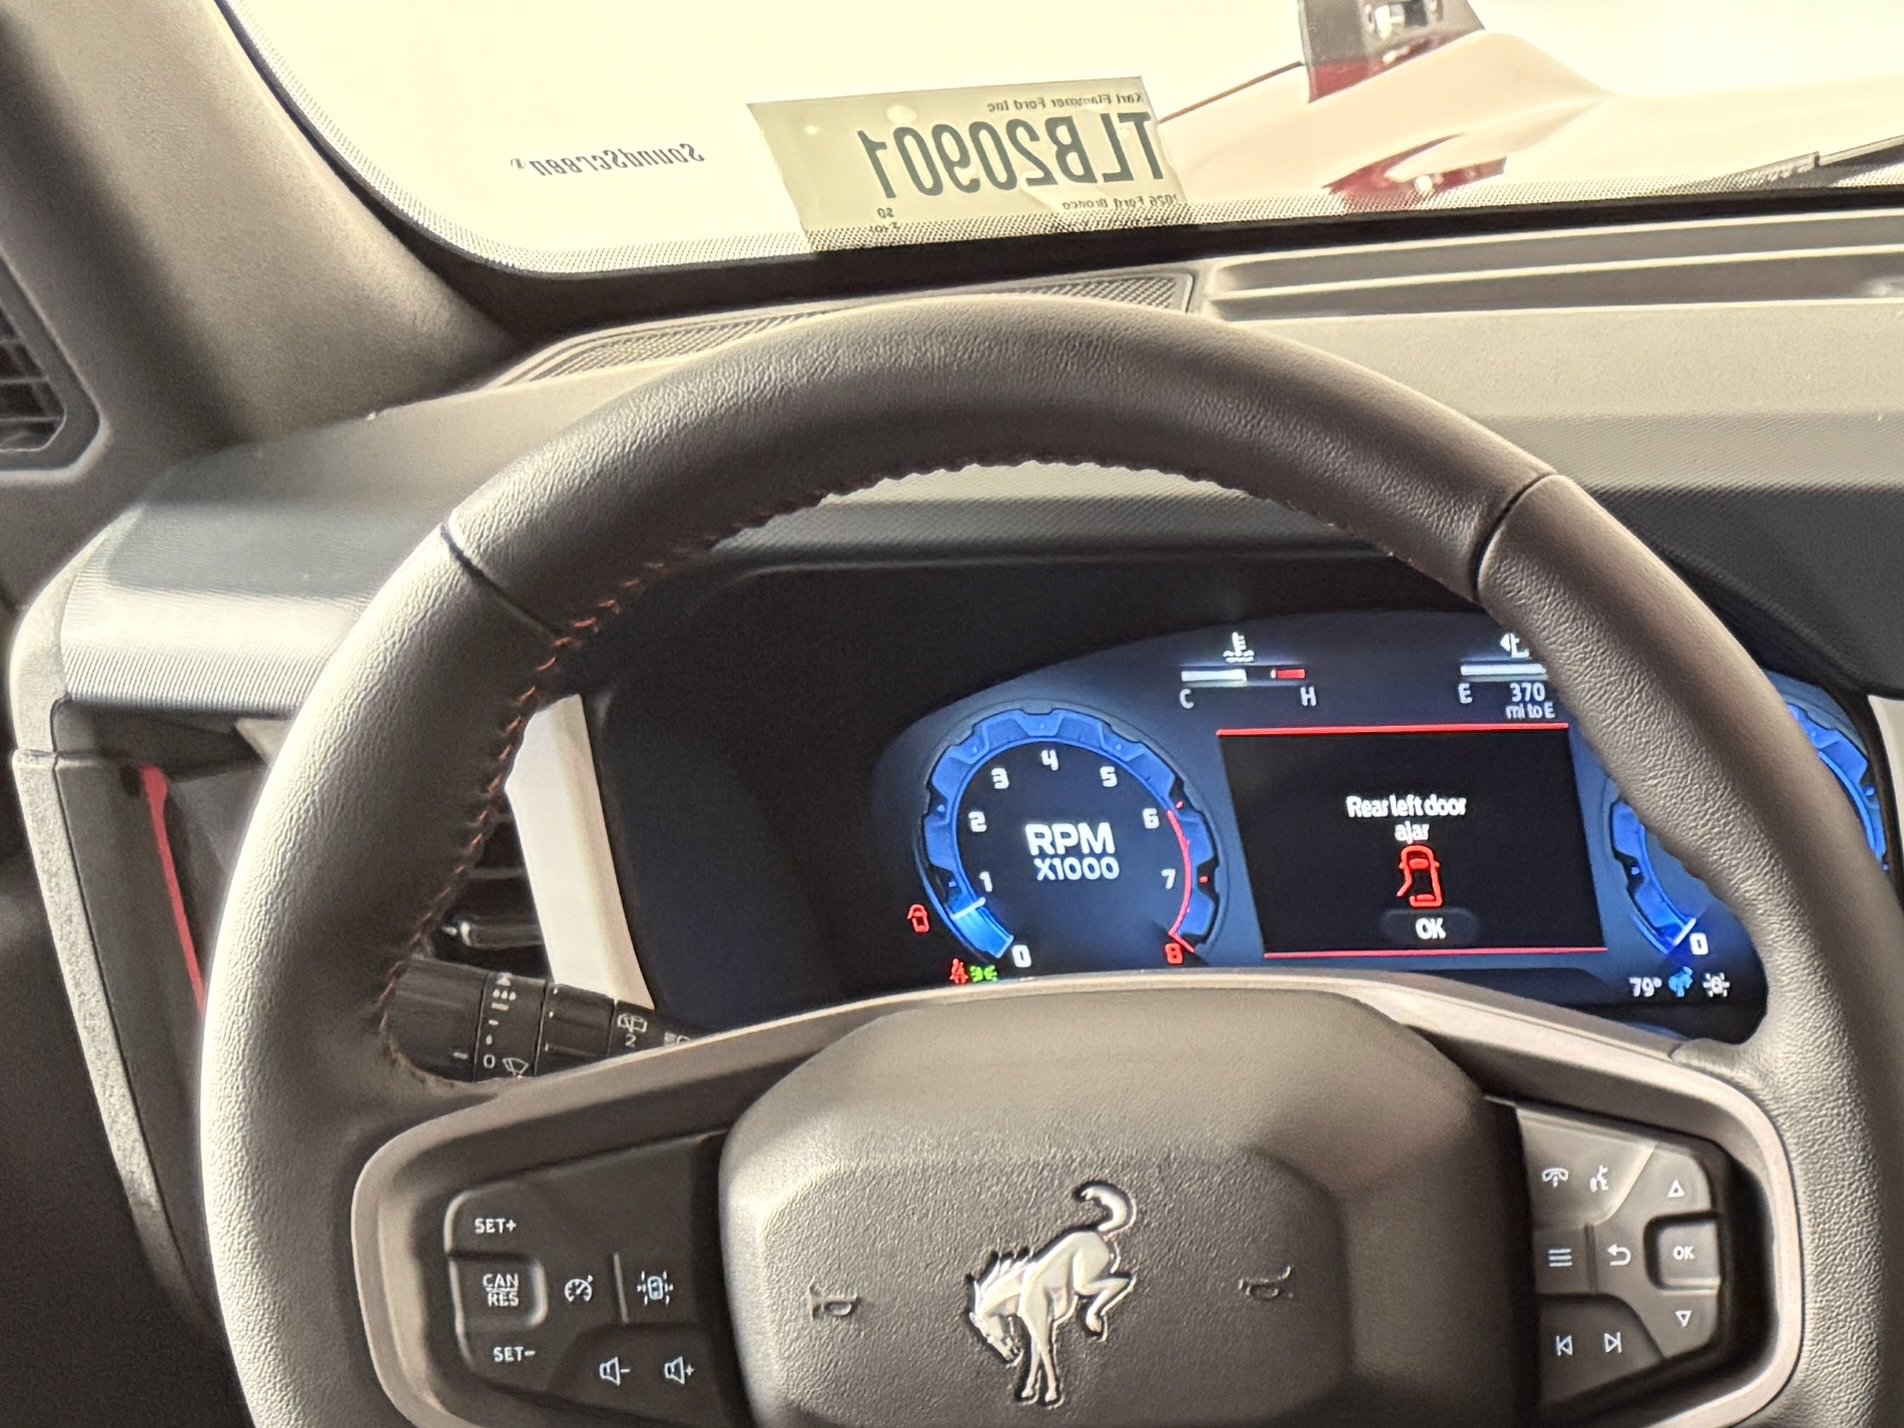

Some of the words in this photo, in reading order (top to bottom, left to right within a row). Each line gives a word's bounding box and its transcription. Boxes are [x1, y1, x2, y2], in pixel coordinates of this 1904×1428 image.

[1179, 688, 1194, 709] C
[1301, 686, 1317, 706] H
[1458, 683, 1472, 704] E
[1510, 682, 1546, 702] 370
[1543, 704, 1555, 719] E
[1041, 750, 1060, 771] 4
[991, 767, 1010, 789] 3
[1100, 766, 1118, 787] 5
[1345, 795, 1389, 818] Rear
[1389, 793, 1424, 817] left
[1424, 793, 1467, 817] door
[968, 811, 987, 833] 2
[1142, 808, 1160, 829] 6
[1024, 822, 1116, 856] RPM
[1394, 820, 1430, 845] ajar
[1033, 856, 1120, 881] X1000
[979, 871, 993, 893] 1
[1160, 869, 1176, 890] 7
[1415, 917, 1447, 940] OK
[1165, 942, 1184, 965] 8
[1689, 931, 1709, 956] 0
[1011, 944, 1032, 968] 0
[1628, 976, 1662, 997] 79°
[474, 1218, 517, 1234] SET+
[1673, 1245, 1695, 1261] OK
[483, 1273, 519, 1289] CAN
[487, 1292, 519, 1307] RES
